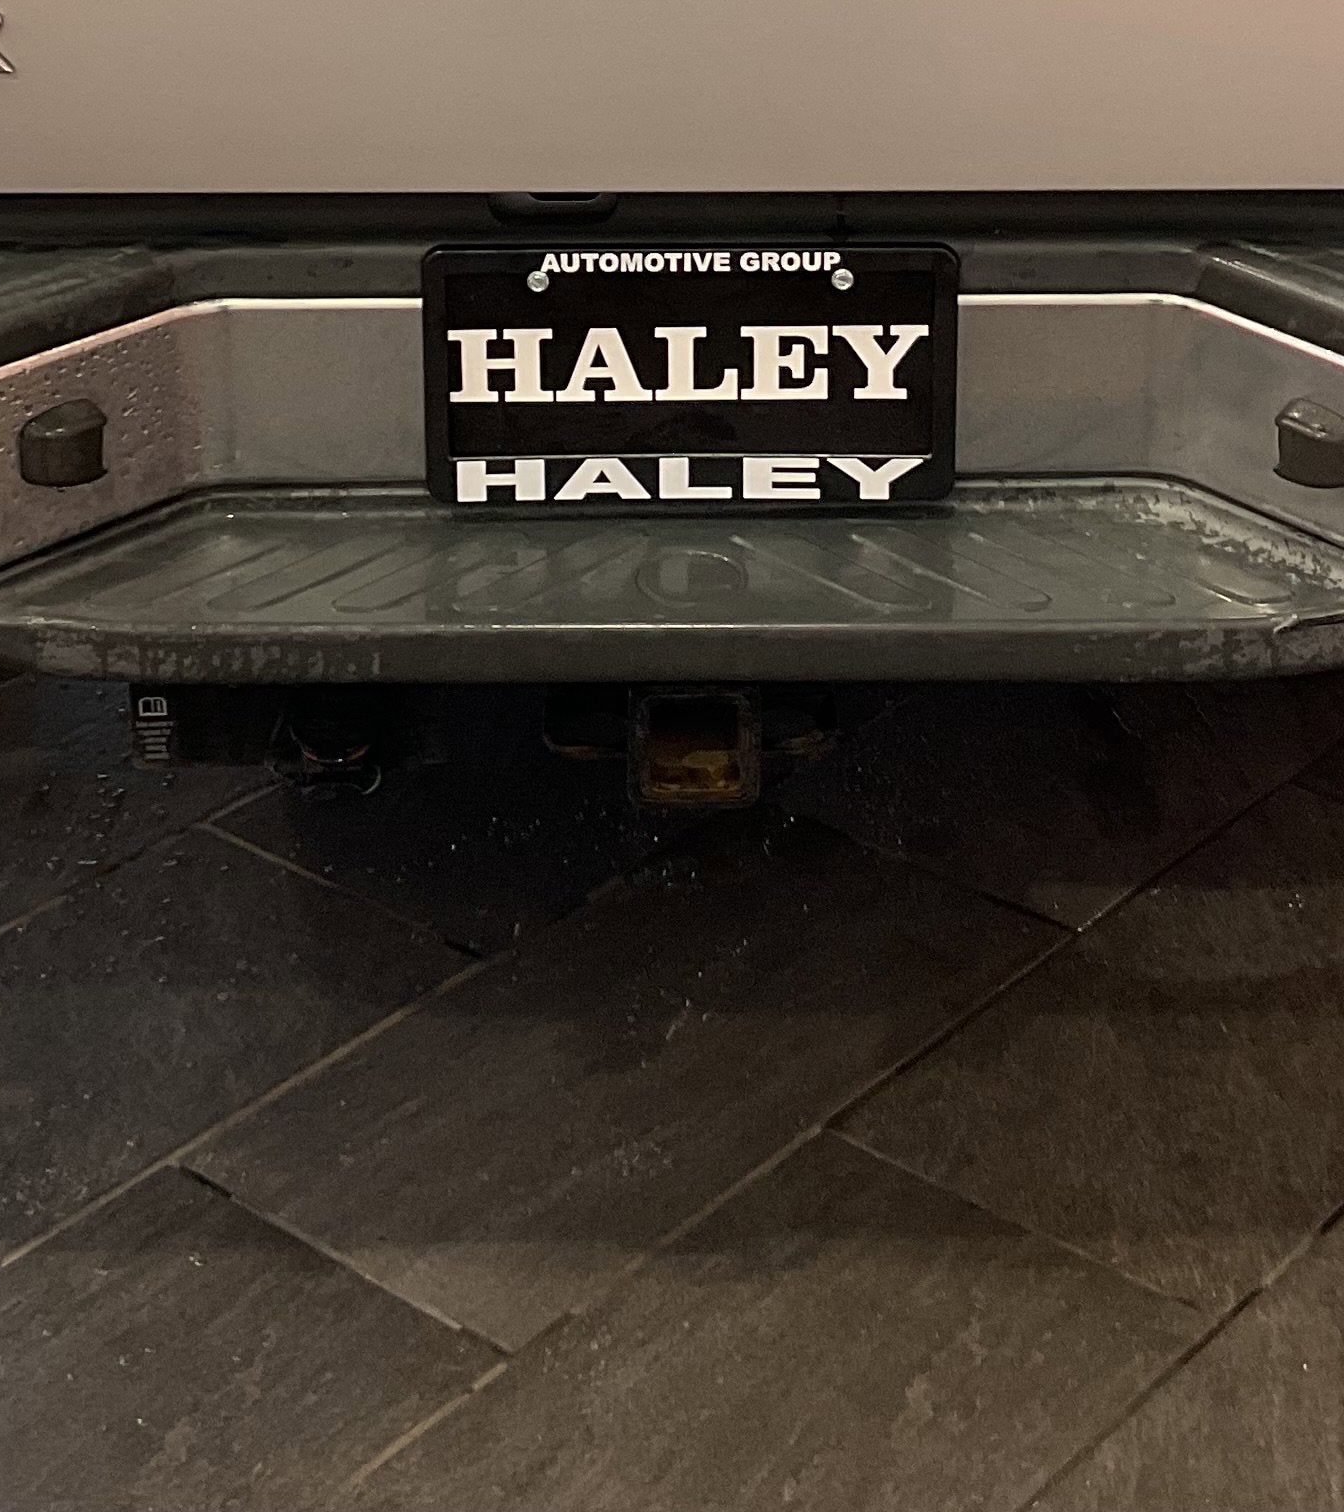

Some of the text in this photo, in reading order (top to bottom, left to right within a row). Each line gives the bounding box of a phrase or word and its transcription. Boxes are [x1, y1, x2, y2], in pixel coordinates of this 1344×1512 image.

[540, 251, 842, 273] AUTOMOTIVE GROUP
[446, 324, 929, 402] HALEY
[455, 456, 924, 502] HALEY
